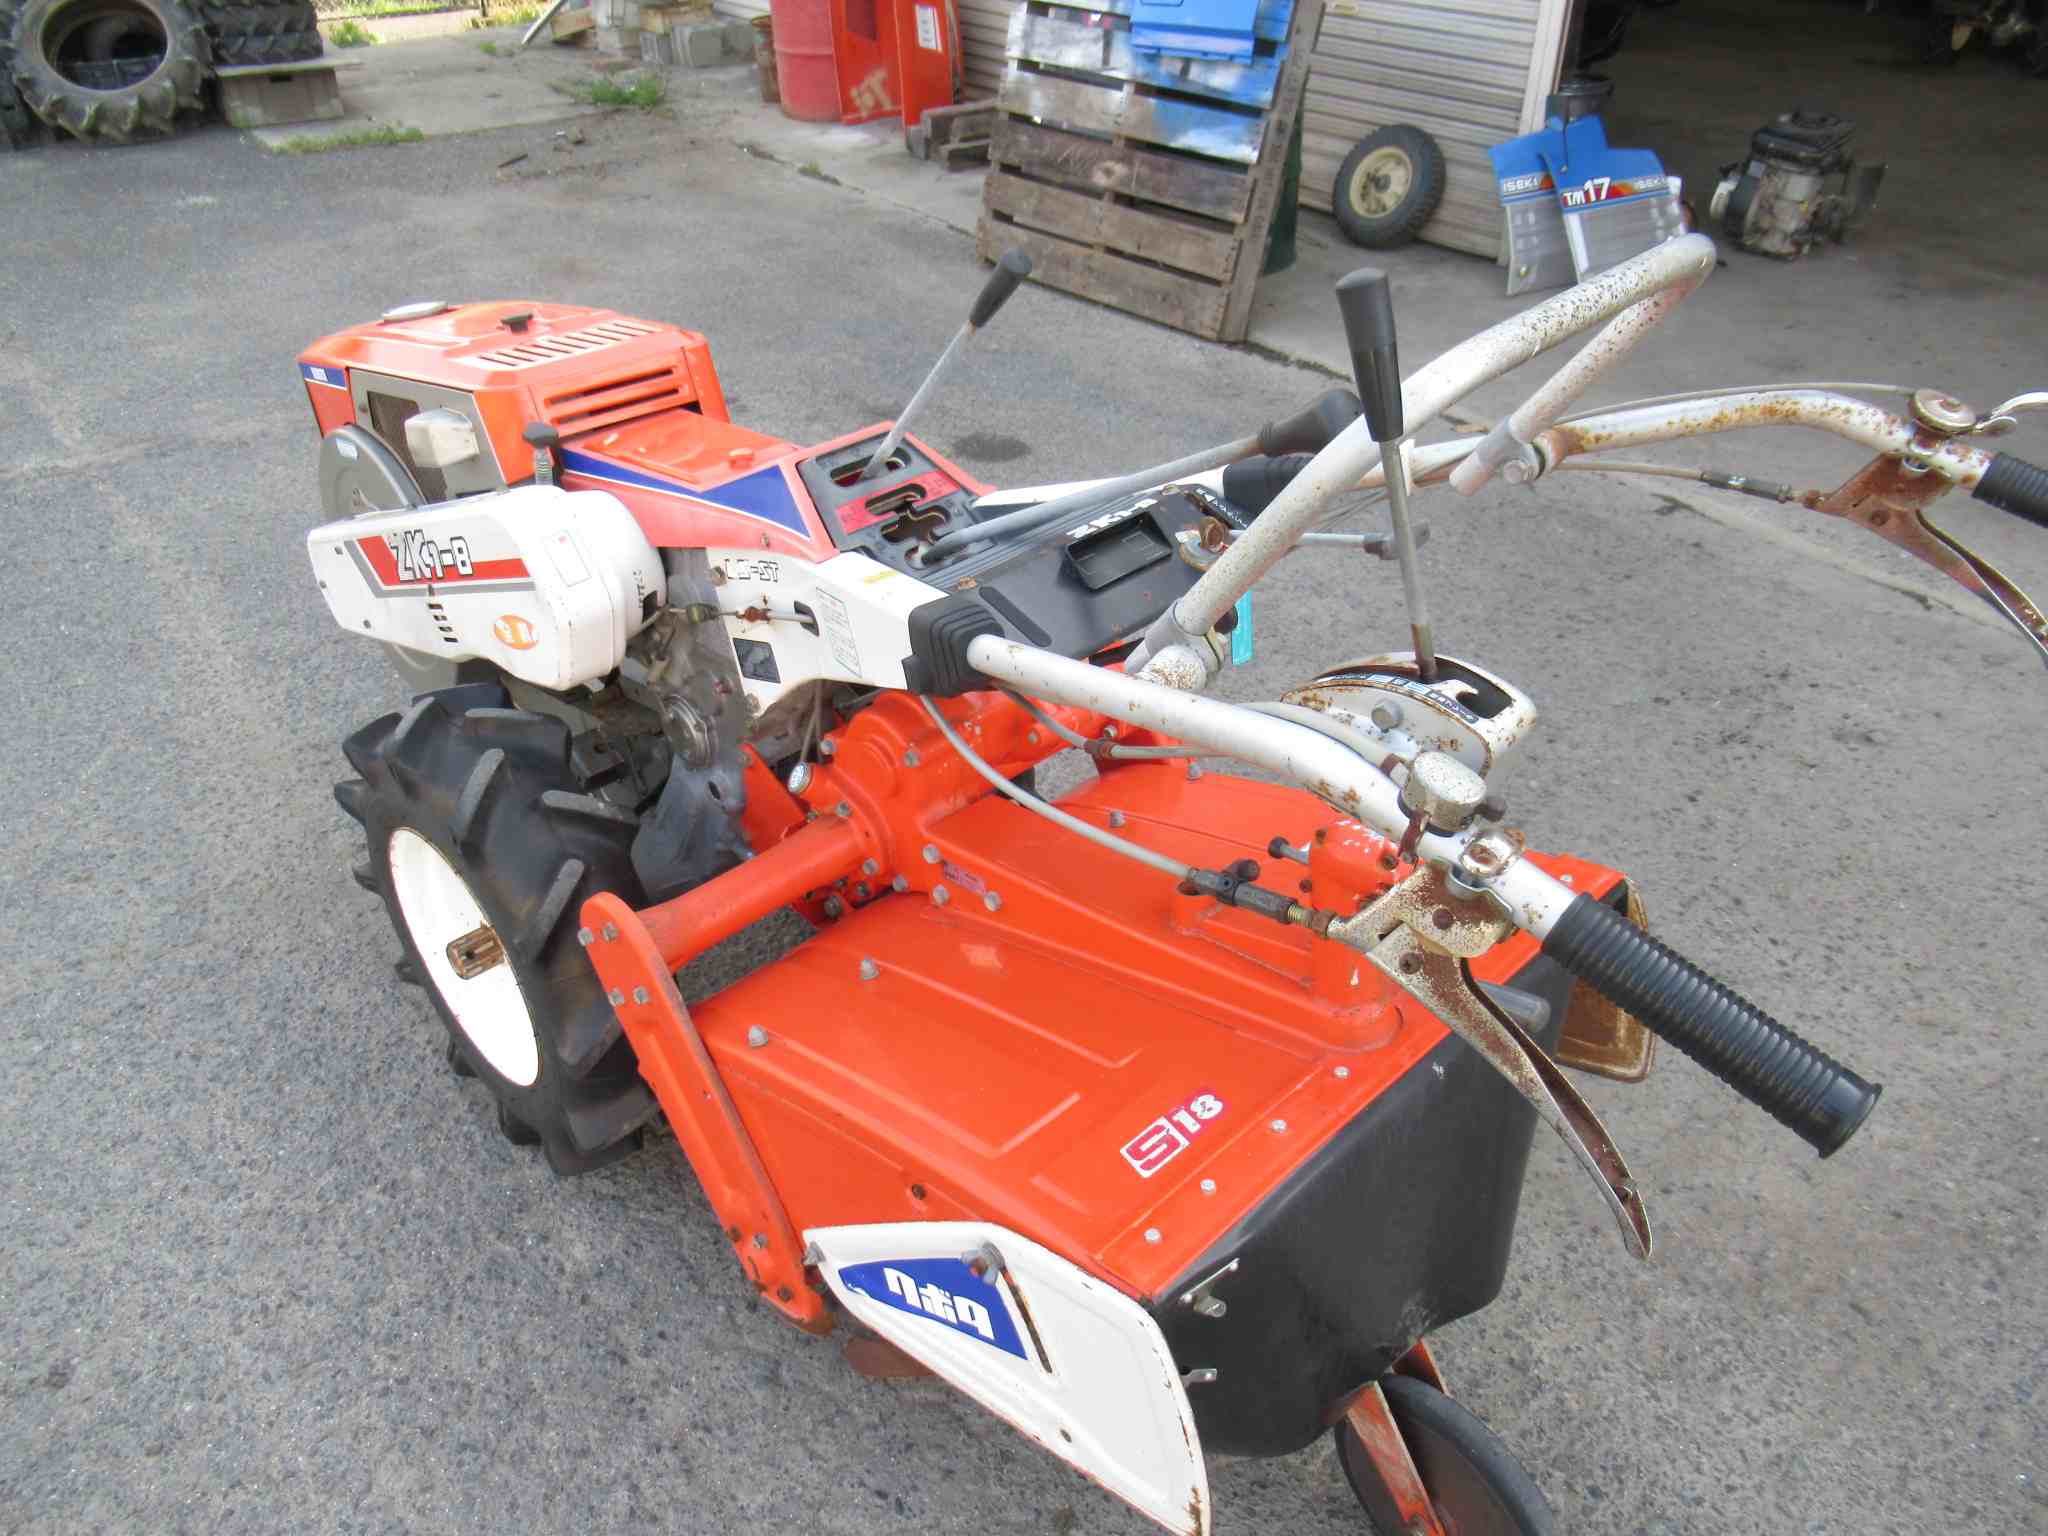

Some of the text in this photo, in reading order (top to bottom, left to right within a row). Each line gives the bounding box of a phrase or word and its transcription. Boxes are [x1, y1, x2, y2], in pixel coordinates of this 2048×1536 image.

[1121, 1094, 1224, 1177] S18
[883, 1267, 995, 1340] クボタ
